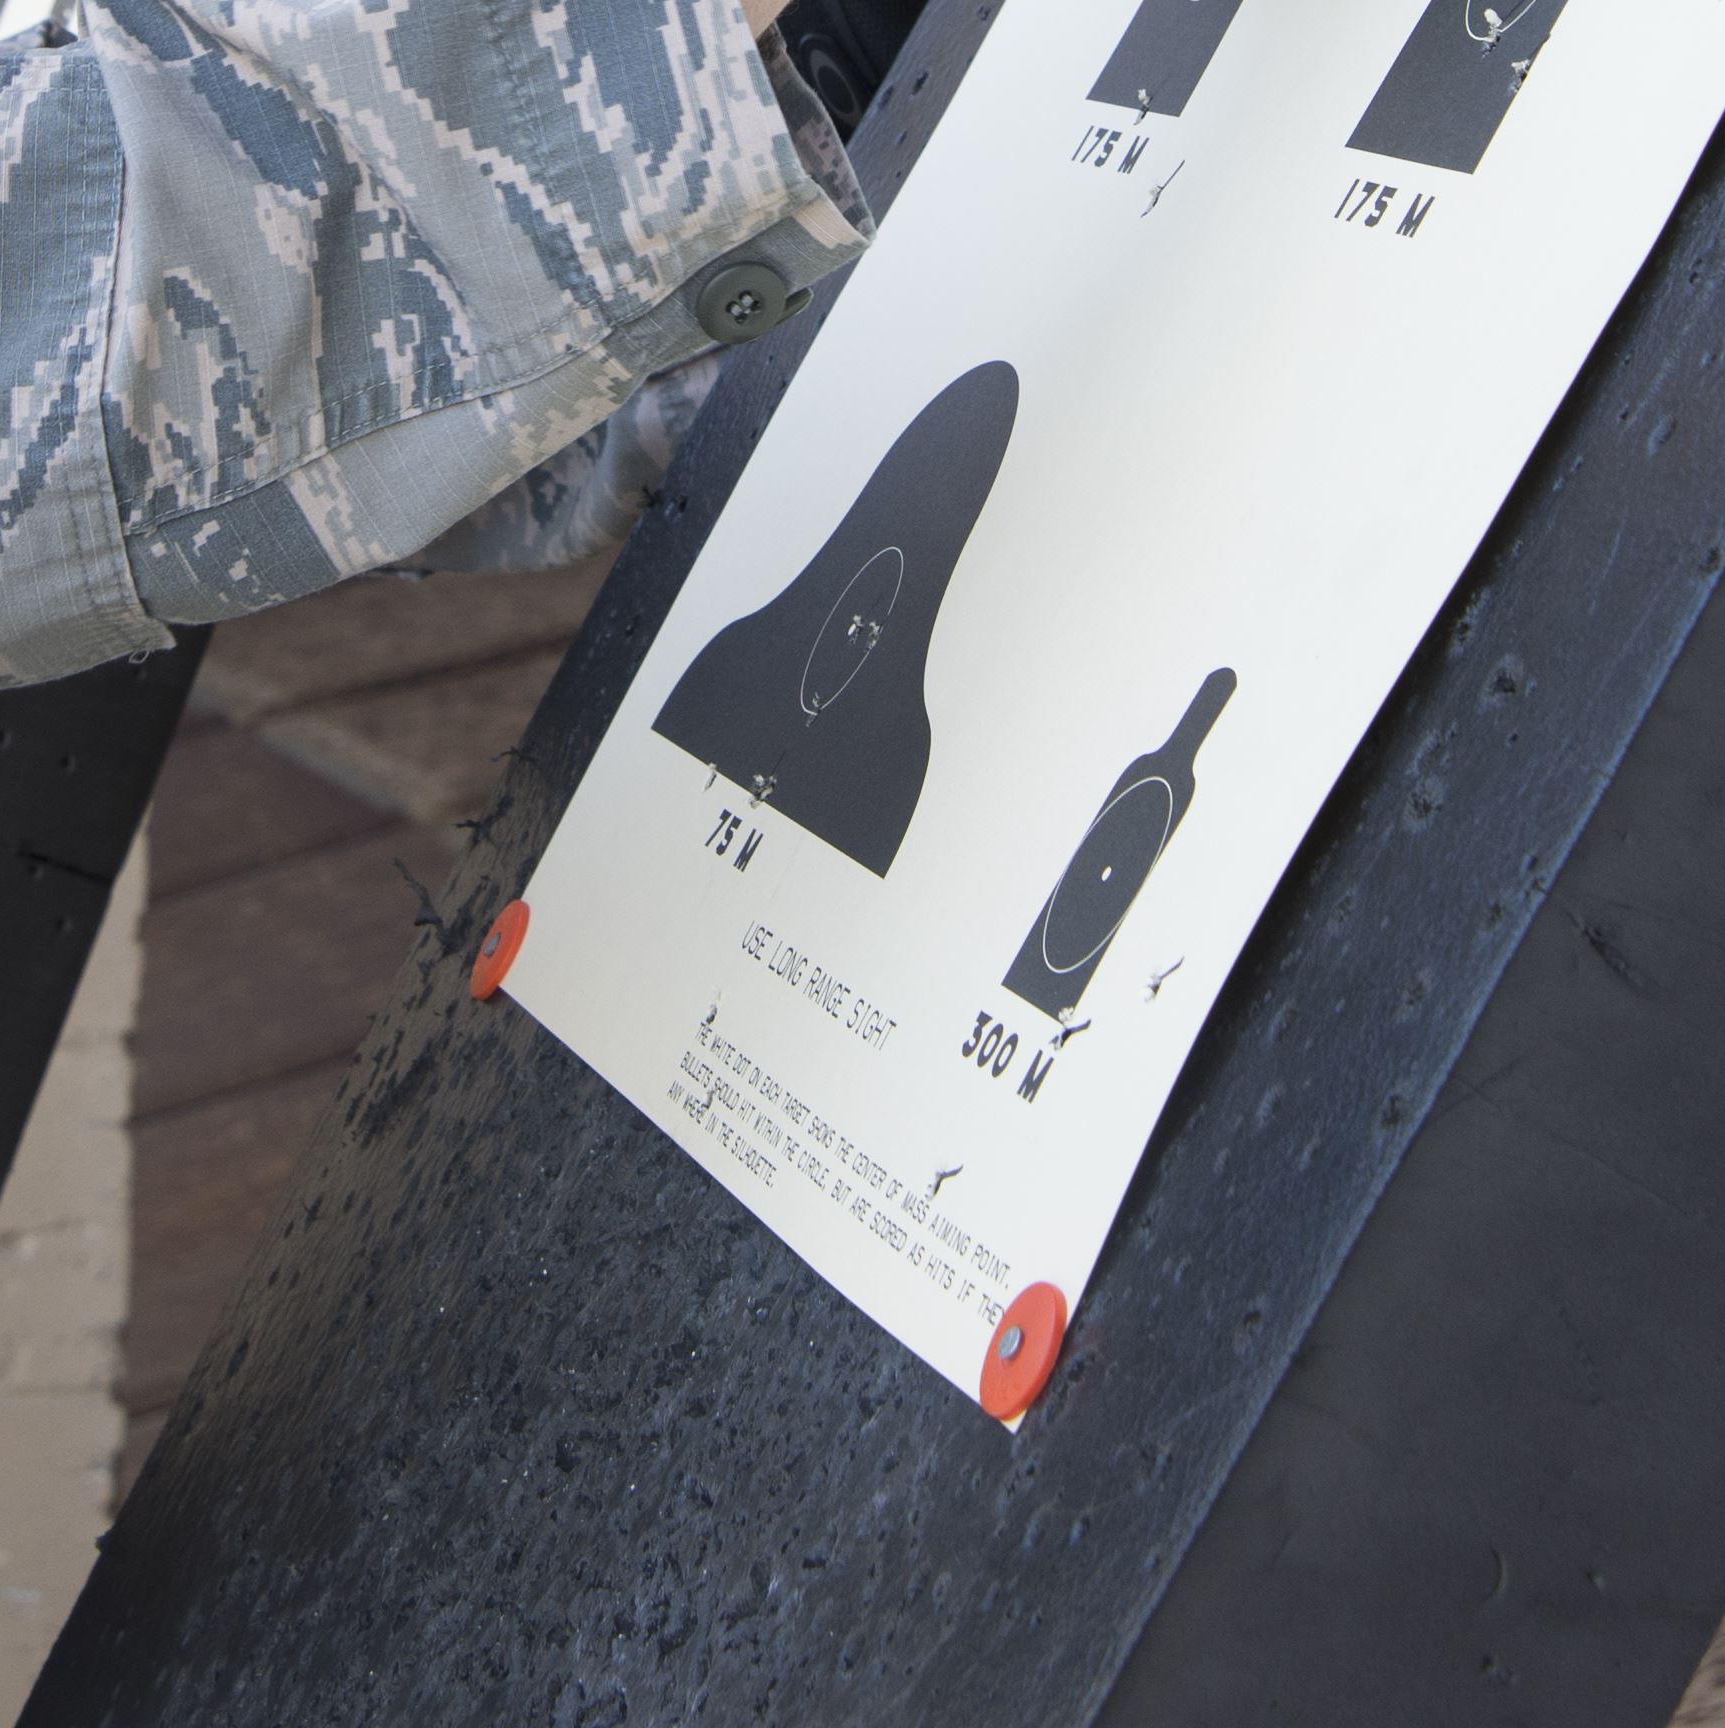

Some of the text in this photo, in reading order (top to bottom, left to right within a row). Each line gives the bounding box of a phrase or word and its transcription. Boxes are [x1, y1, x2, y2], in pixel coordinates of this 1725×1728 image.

[1071, 125, 1150, 174] 175 M
[1334, 178, 1435, 238] 175 M
[705, 808, 764, 873] 75 M
[742, 920, 897, 1051] USE LONG RANGE SIGHT
[962, 1010, 1054, 1104] 300 M
[667, 1080, 685, 1104] ANY
[682, 1093, 710, 1124] WHERE
[705, 1112, 719, 1135] IN
[716, 1123, 734, 1148] THE
[680, 1051, 713, 1089] BULLETS
[714, 1077, 740, 1111] SHOULD
[737, 1099, 756, 1123] HIT
[754, 1112, 783, 1148] WITHIN
[781, 1136, 799, 1162] THE
[831, 1179, 852, 1205] BUT
[849, 1195, 872, 1223] ARE
[869, 1211, 907, 1252] SCORED
[907, 1241, 925, 1266] AS
[924, 1254, 955, 1290] HITS
[957, 1279, 975, 1303] IF
[695, 1022, 1010, 1289] THE WHITE DOT ON EACH TARGET SHOWS THE CENTER OF MASS AIMING POINT.
